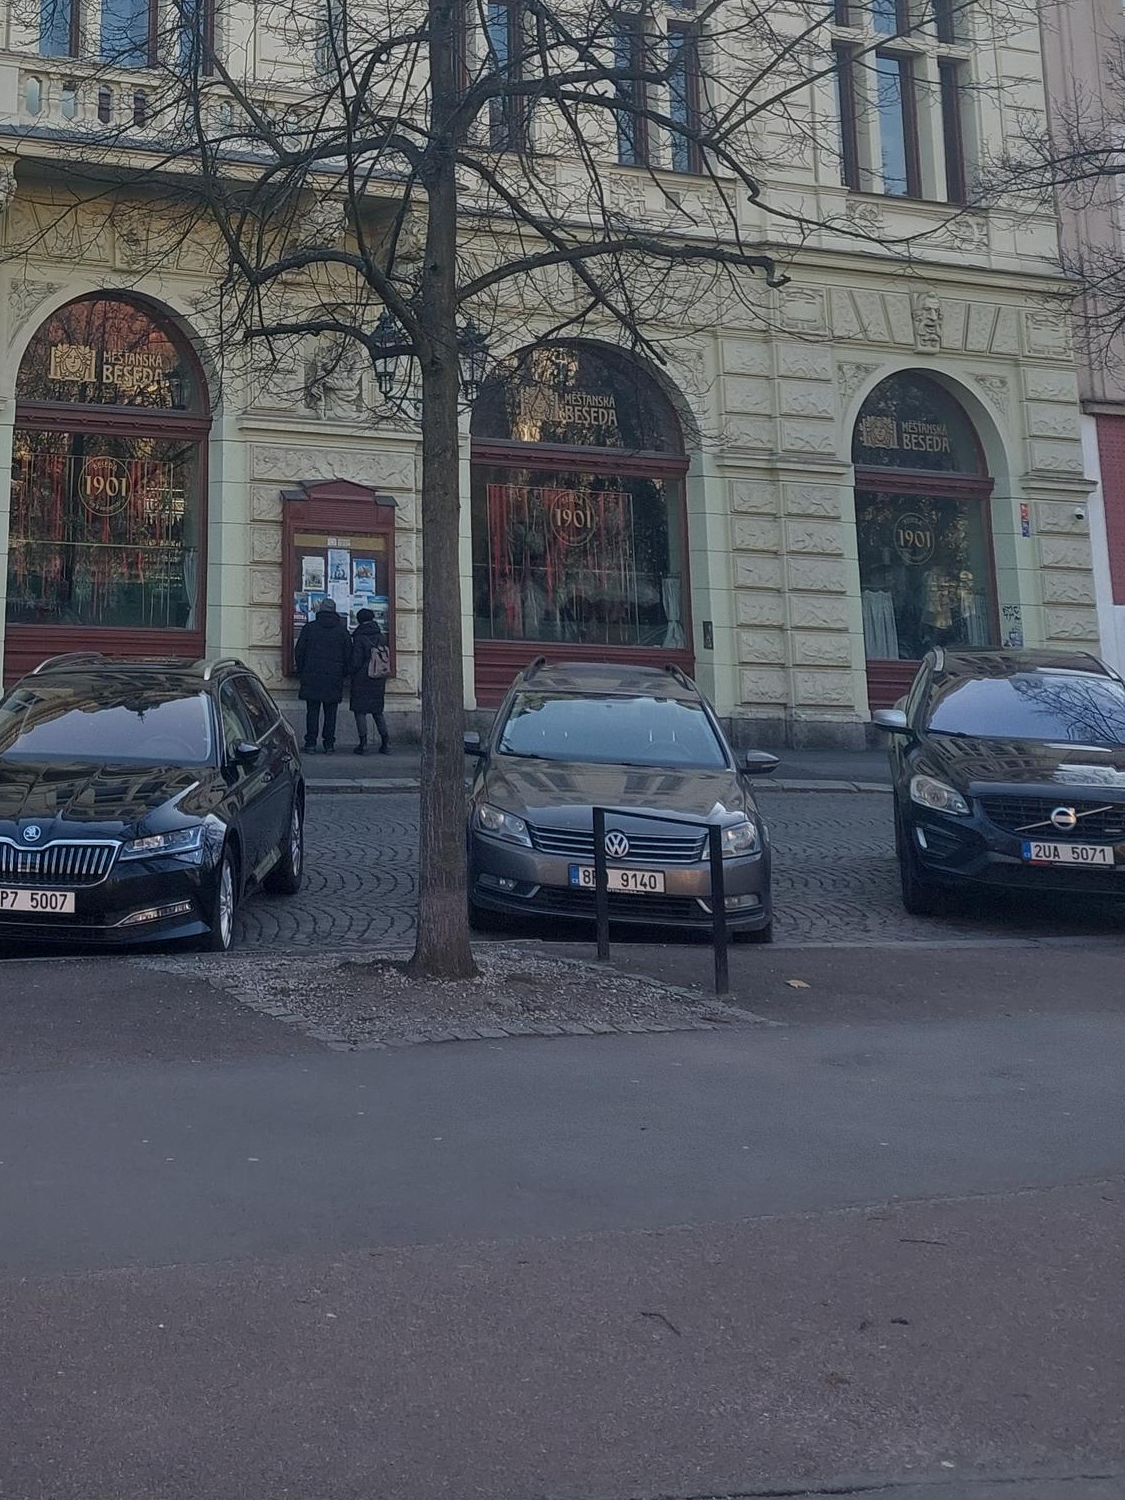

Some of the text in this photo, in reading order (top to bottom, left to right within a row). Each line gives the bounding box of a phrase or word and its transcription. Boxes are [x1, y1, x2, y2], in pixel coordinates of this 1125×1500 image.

[102, 364, 164, 388] BESEDA
[565, 405, 618, 427] BESEDA
[903, 433, 950, 453] BESEDA
[84, 475, 127, 497] 1901
[555, 508, 591, 528] 1901
[898, 529, 931, 548] 1901
[1034, 844, 1107, 862] 2UA 5071
[620, 872, 657, 890] 9140
[30, 892, 68, 911] 5007
